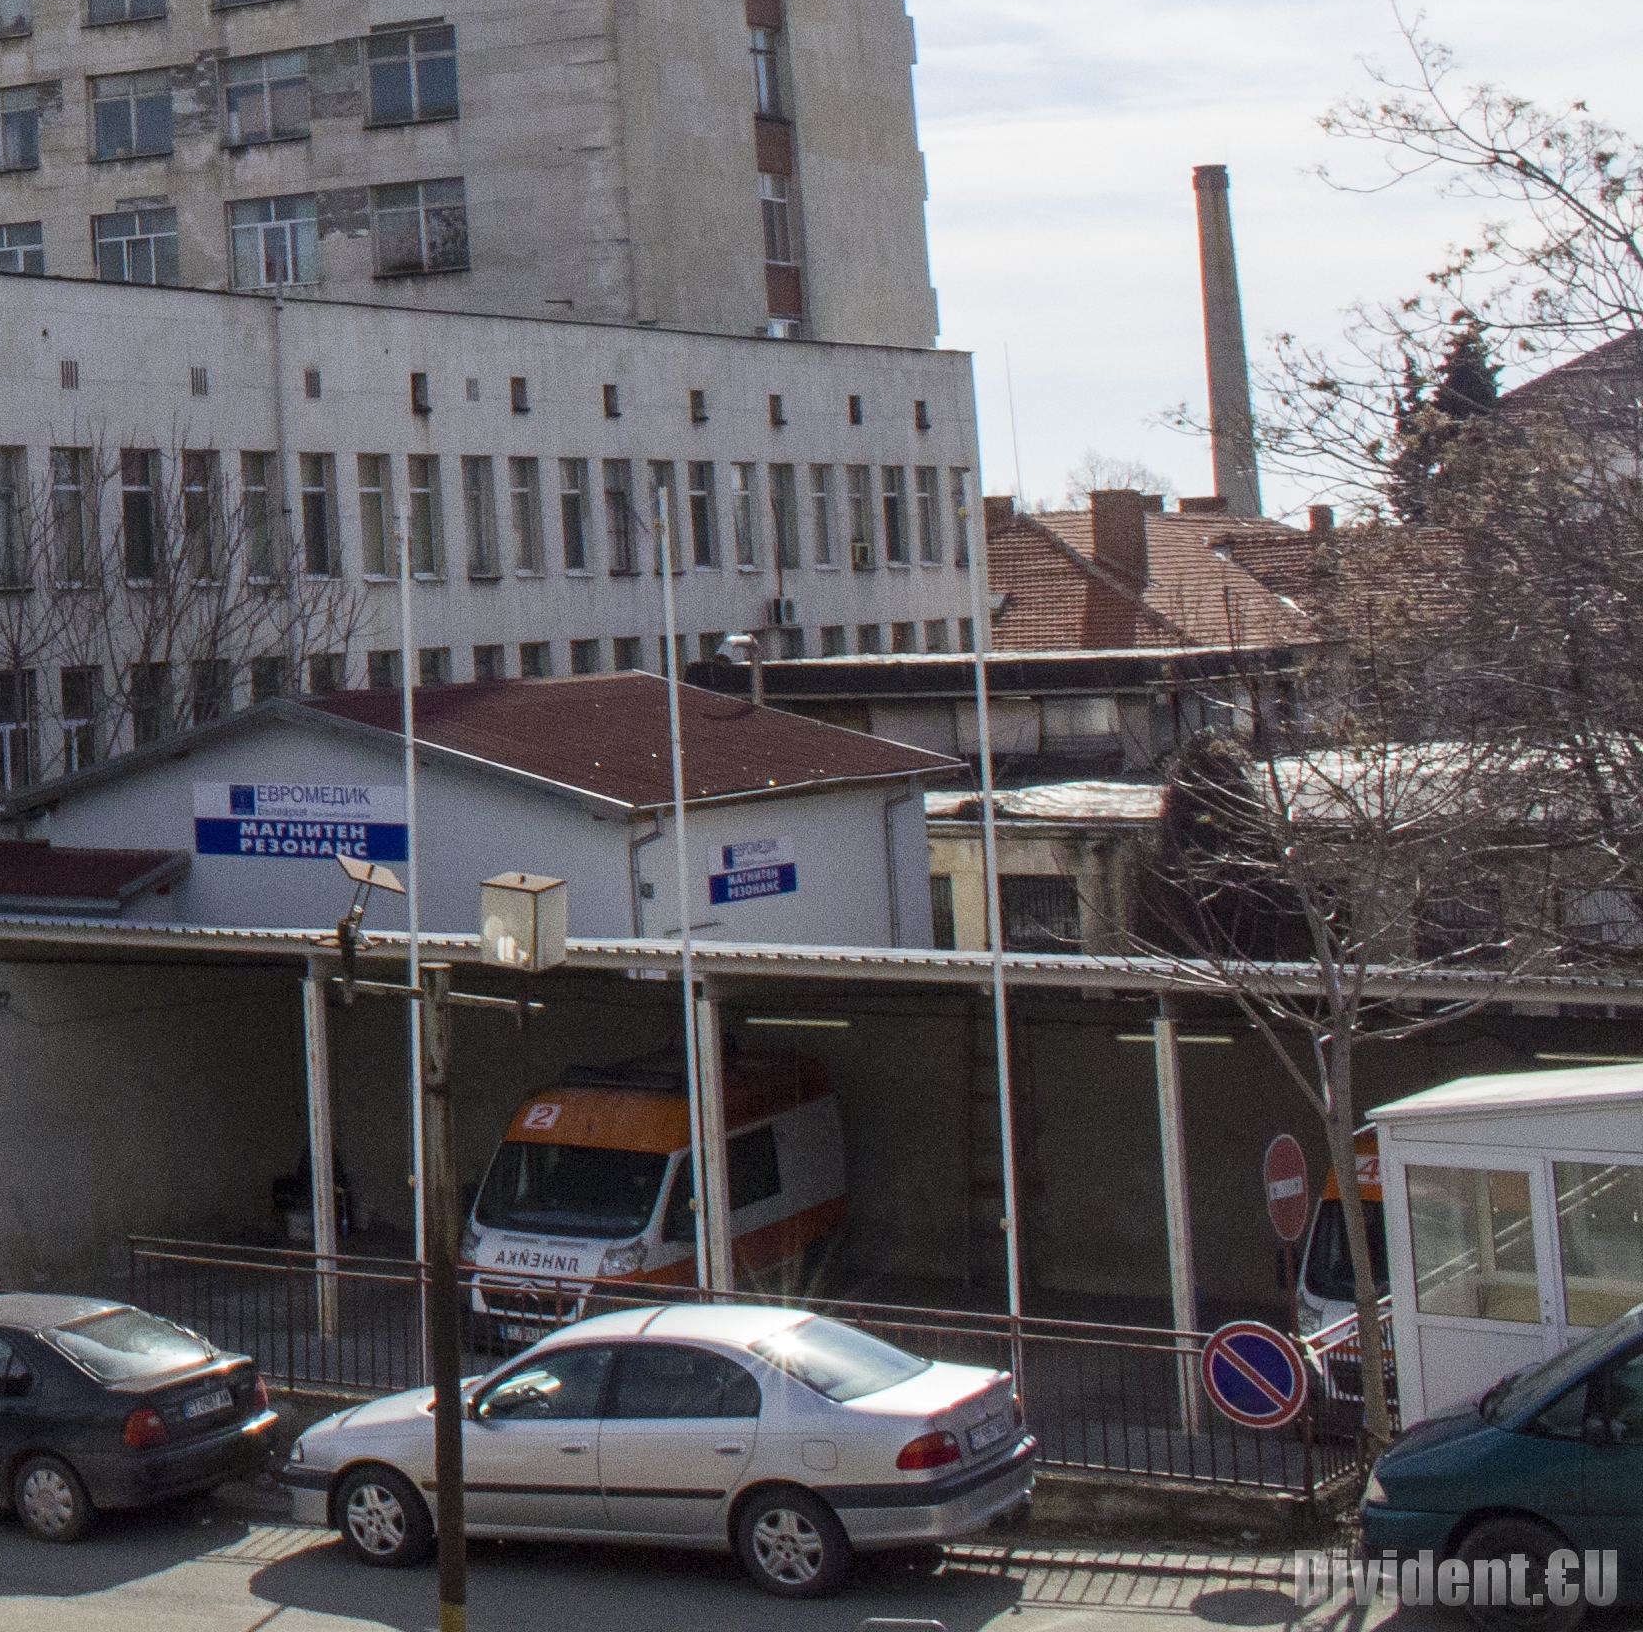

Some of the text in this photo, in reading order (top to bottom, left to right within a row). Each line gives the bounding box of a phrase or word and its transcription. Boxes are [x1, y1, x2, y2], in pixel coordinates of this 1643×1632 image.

[257, 784, 371, 806] ЕВРОМЕДИК
[239, 822, 366, 839] МАГНИТЕН
[239, 838, 369, 856] РЕЗОНАНС
[728, 868, 780, 884] МАГНИТЕН
[728, 880, 781, 899] РЕЗОНАНС
[531, 1106, 553, 1126] 2
[1355, 1158, 1380, 1180] 4
